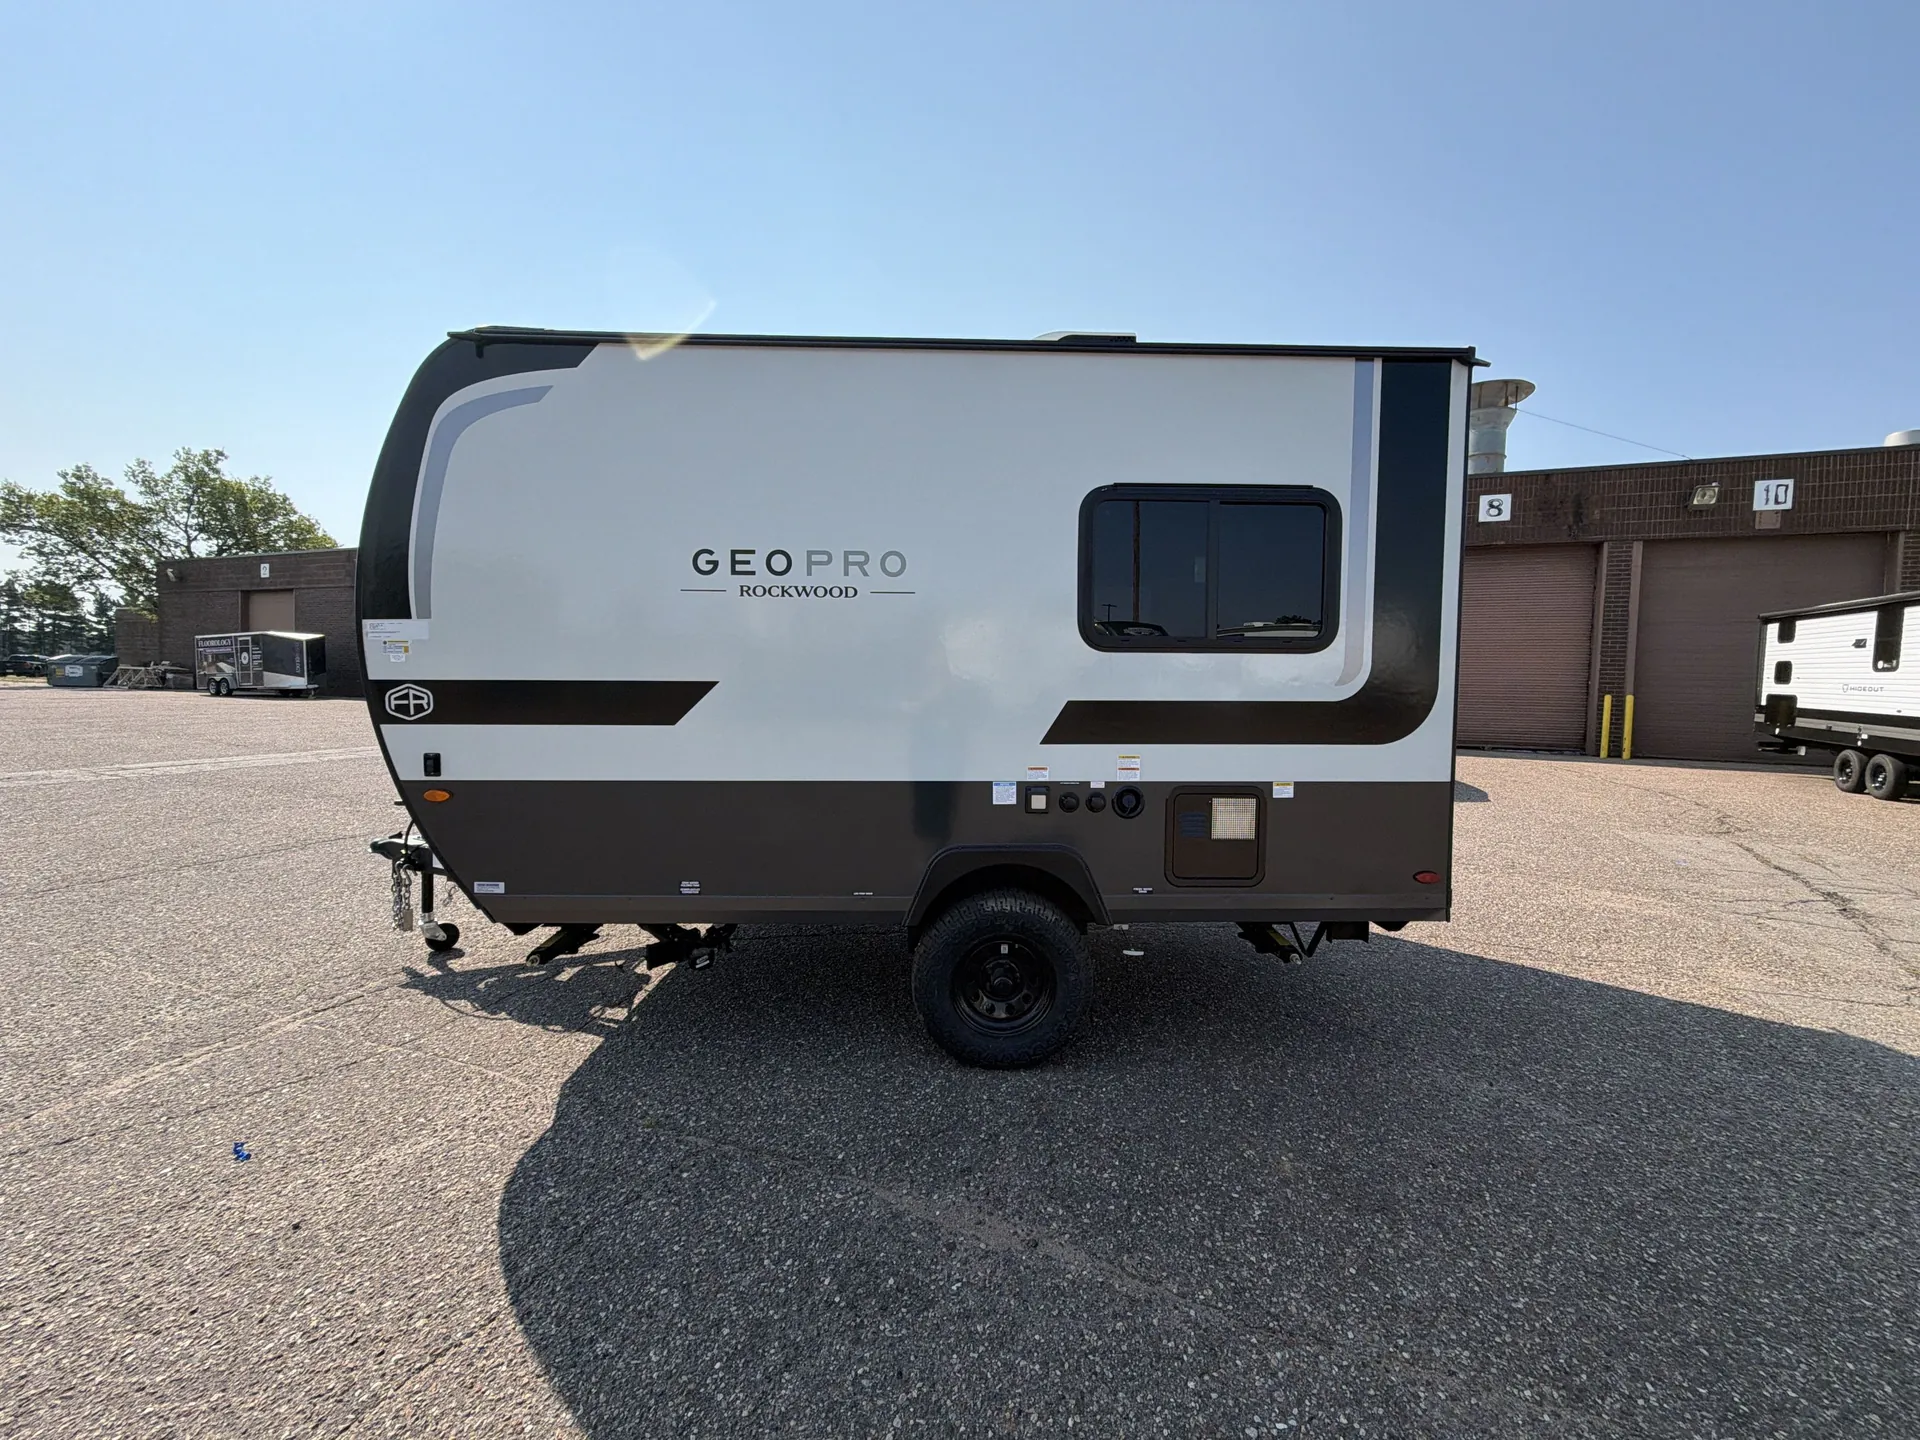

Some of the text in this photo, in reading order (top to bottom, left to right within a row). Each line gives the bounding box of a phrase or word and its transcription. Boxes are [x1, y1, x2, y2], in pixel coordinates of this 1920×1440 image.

[1763, 484, 1789, 505] 10
[1486, 498, 1503, 517] 8
[739, 584, 858, 598] ROCKWOOD
